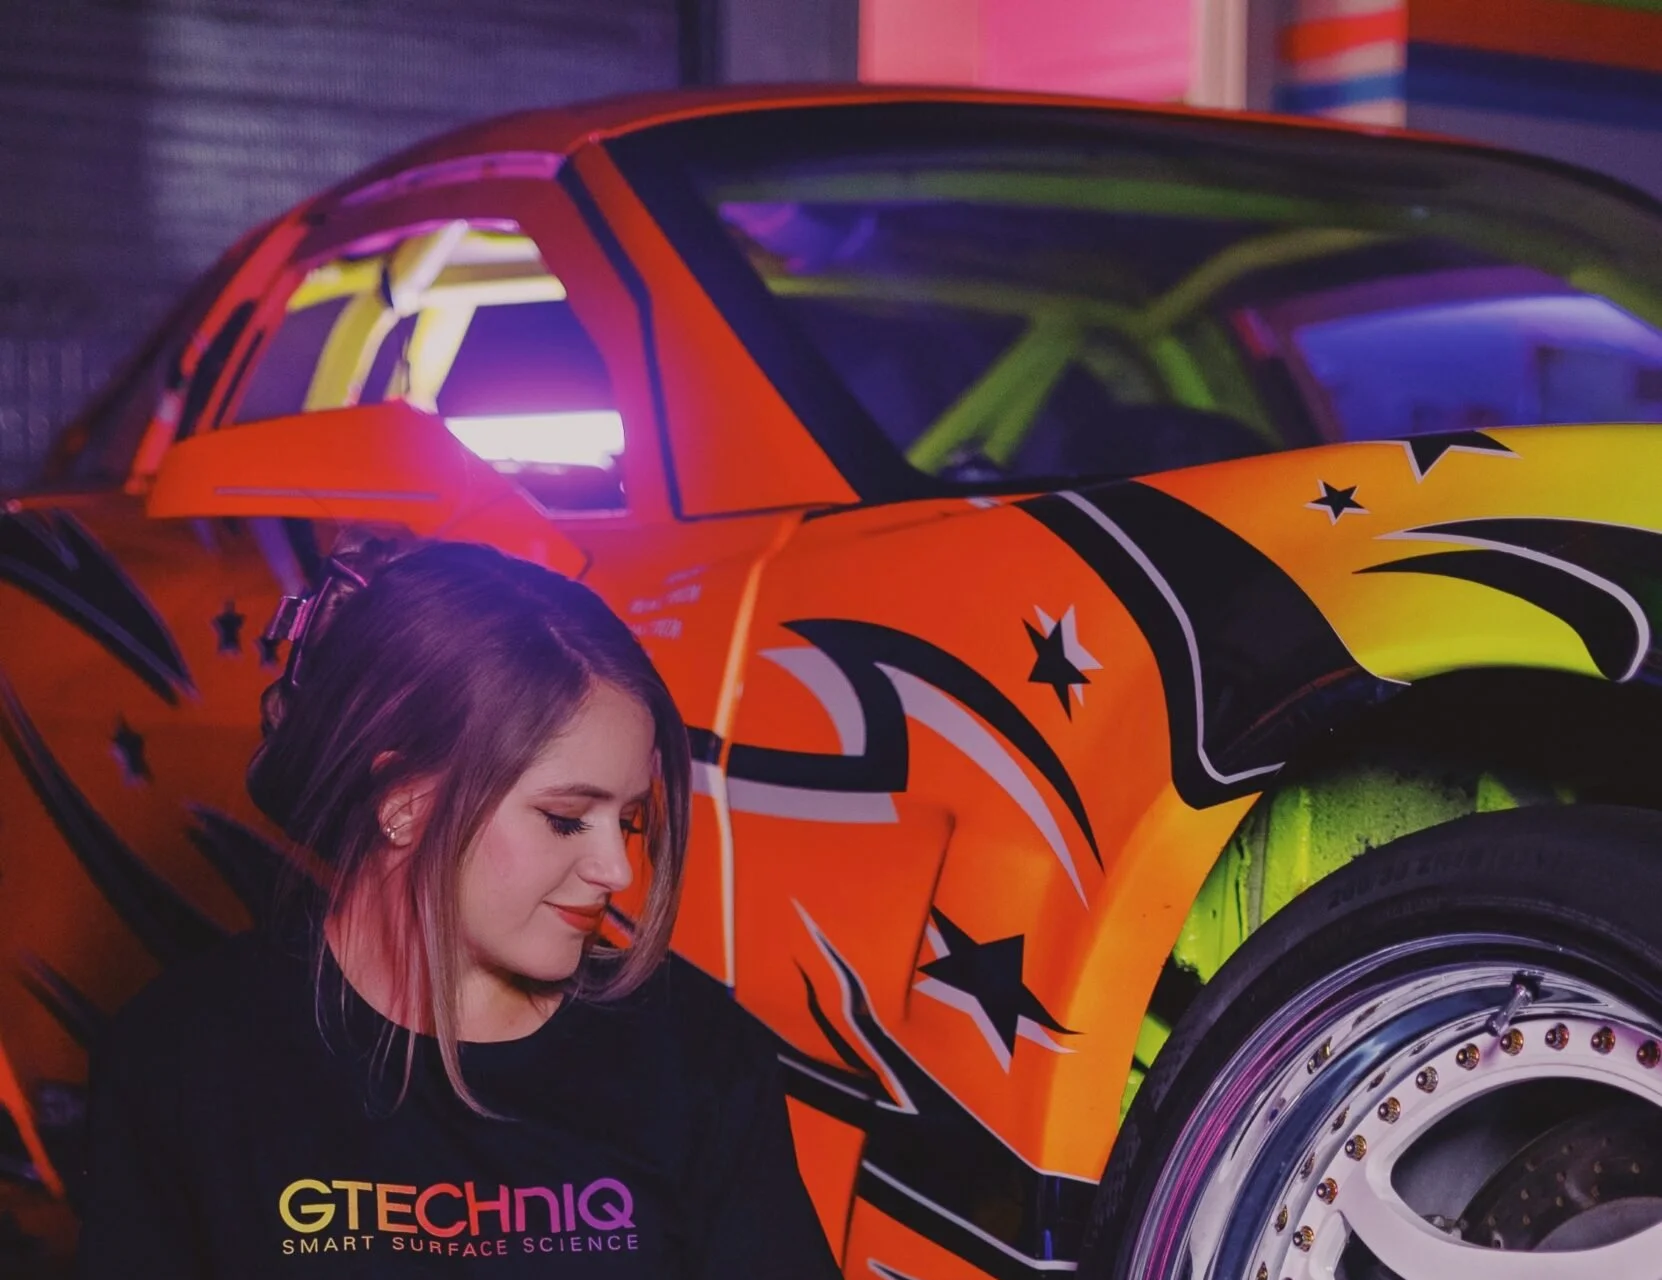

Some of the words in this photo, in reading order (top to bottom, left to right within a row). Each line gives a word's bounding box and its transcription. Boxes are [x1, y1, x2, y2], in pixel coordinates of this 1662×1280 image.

[283, 1235, 375, 1255] SMART
[392, 1236, 507, 1257] SURFACE
[523, 1234, 639, 1253] SCIENCE
